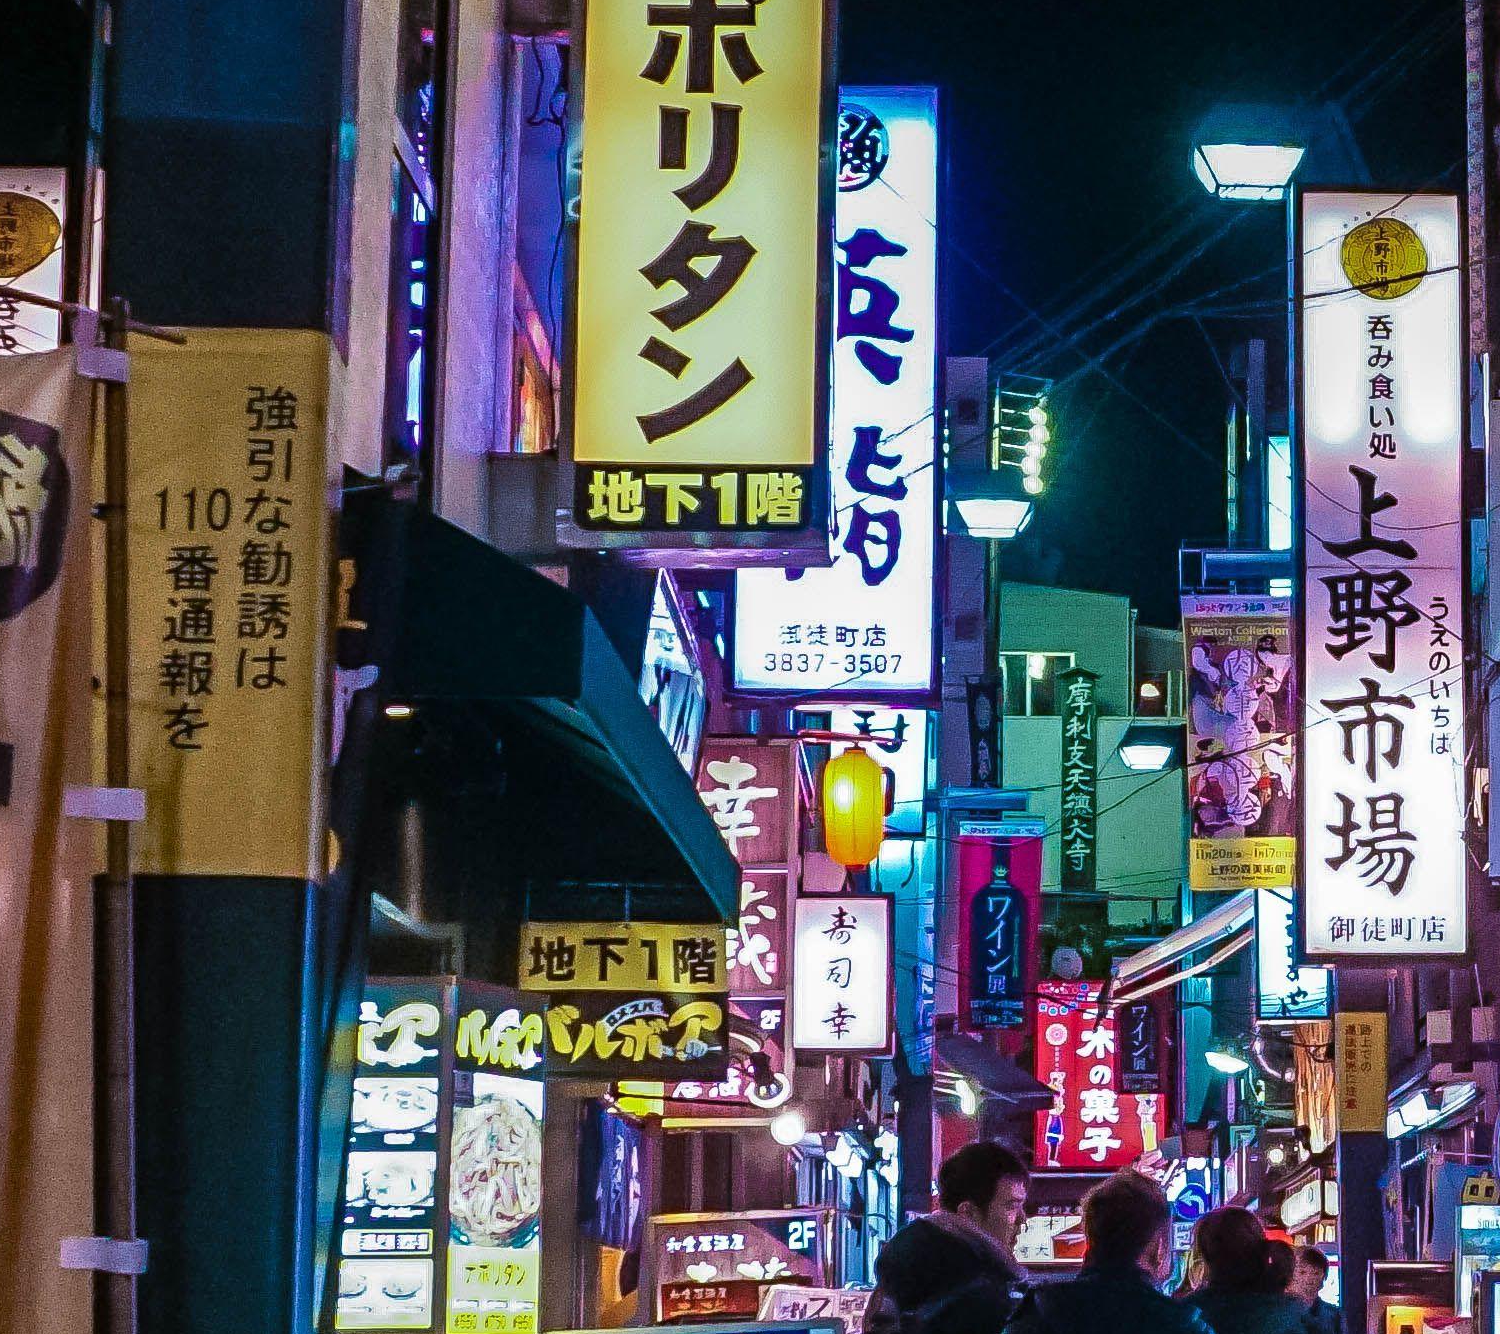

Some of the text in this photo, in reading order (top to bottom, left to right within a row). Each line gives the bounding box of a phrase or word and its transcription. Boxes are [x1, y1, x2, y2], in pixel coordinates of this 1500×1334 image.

[1366, 314, 1398, 460] 呑み食い処
[588, 471, 804, 527] 地下1階
[235, 384, 299, 690] 強引な勧誘は
[154, 487, 232, 751] 110番通報を
[1236, 624, 1289, 637] Collection
[763, 652, 902, 676] 3837-3507
[1320, 464, 1420, 898] 上野市場
[1328, 913, 1447, 943] 御徒町店
[529, 935, 718, 985] 地下1階
[788, 1221, 817, 1249] 2F
